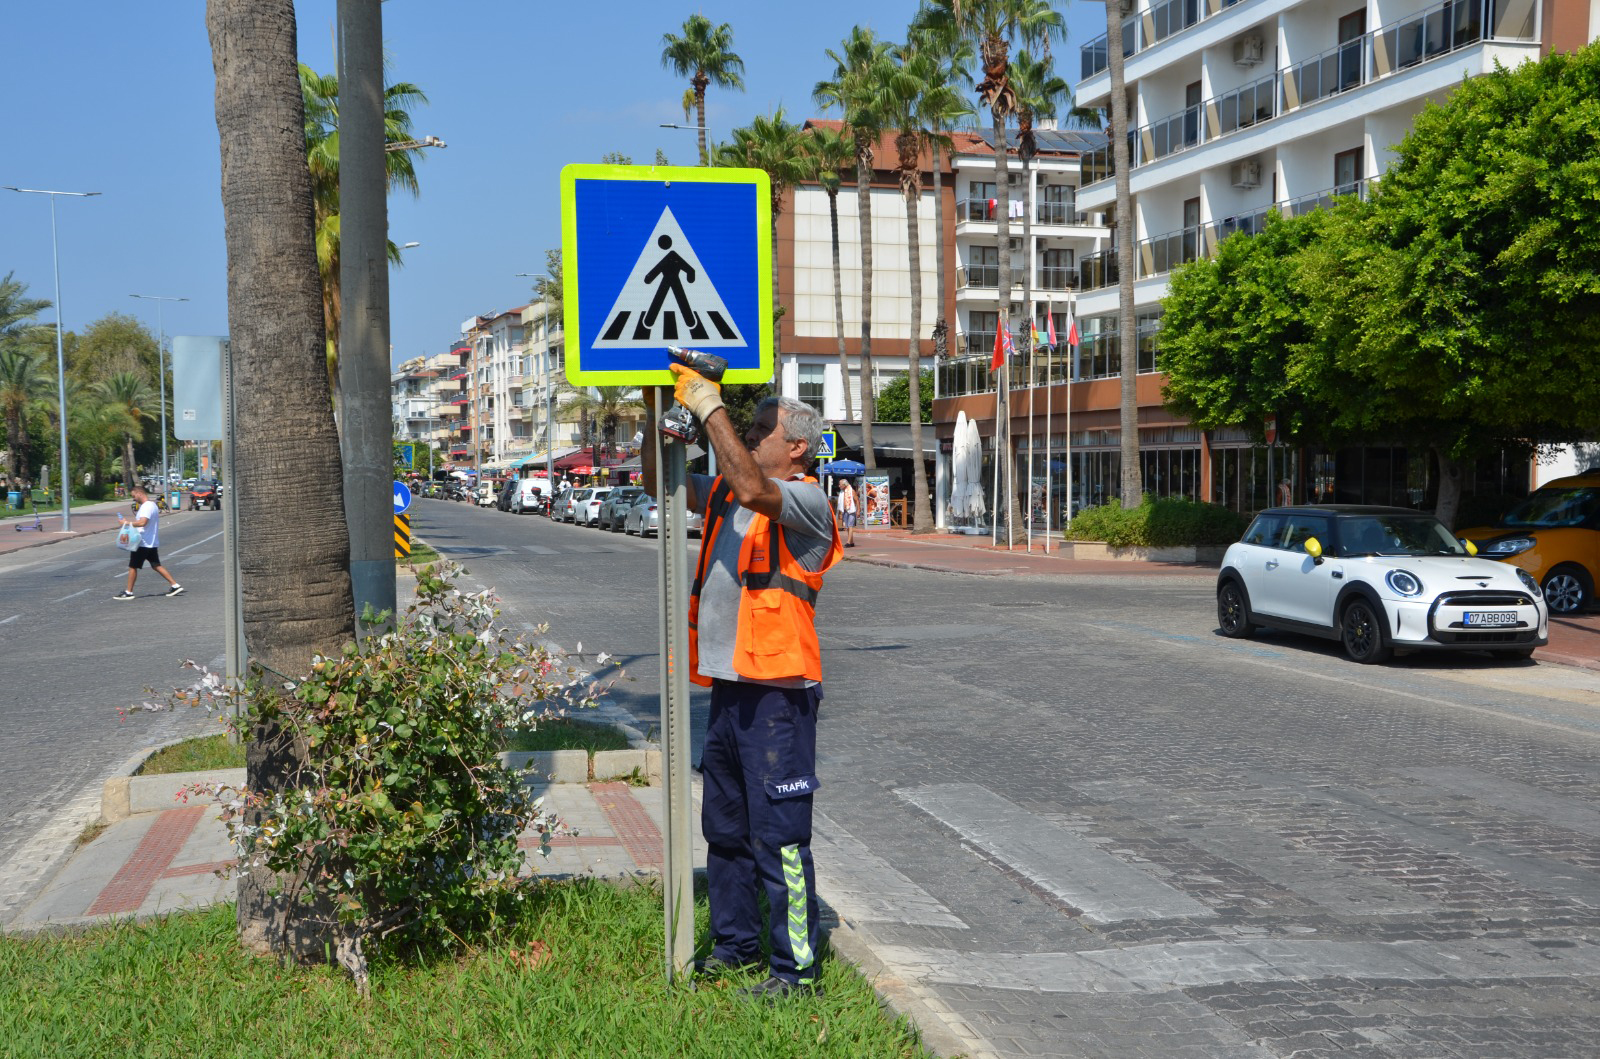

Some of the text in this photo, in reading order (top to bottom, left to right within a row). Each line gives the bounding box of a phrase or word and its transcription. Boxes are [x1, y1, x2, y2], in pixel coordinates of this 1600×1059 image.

[1470, 613, 1516, 624] 07 ABB 099
[776, 779, 809, 793] TRAFİK
